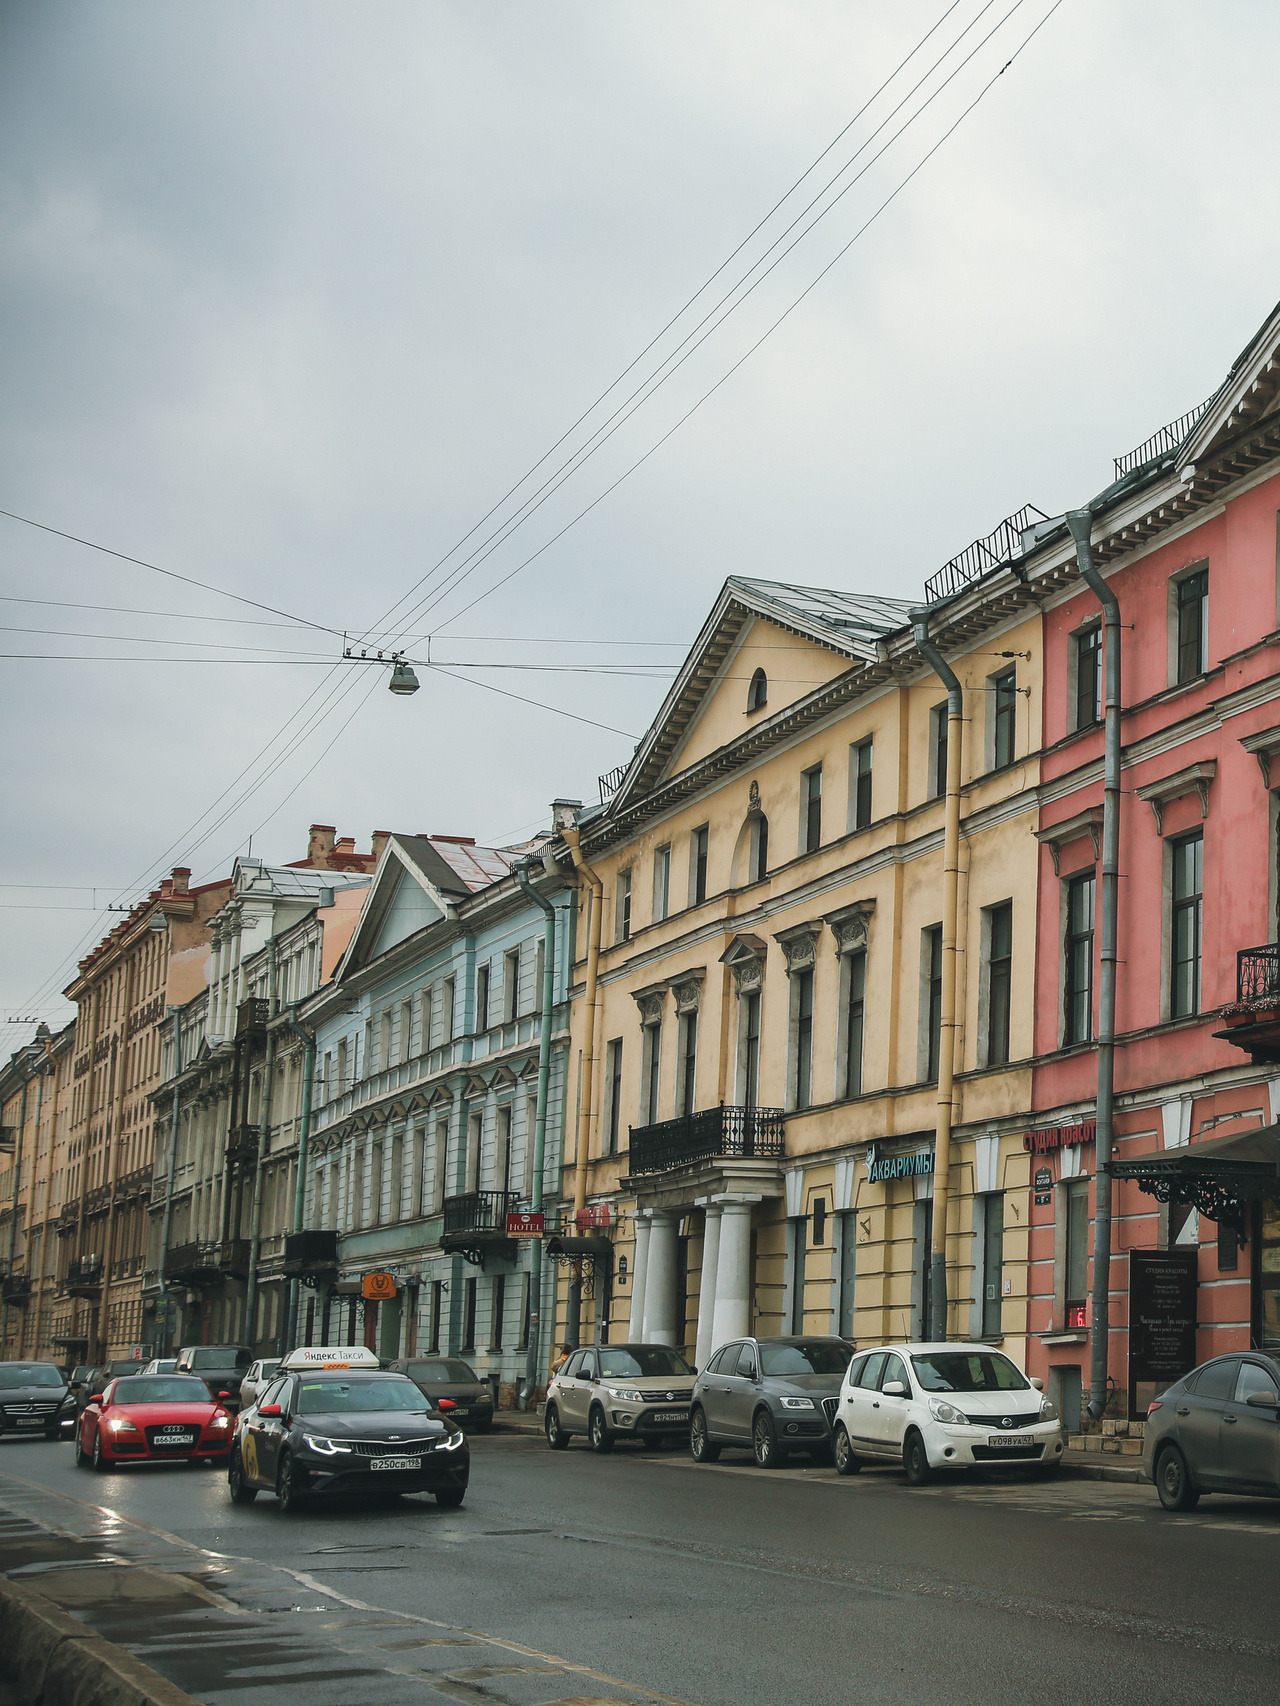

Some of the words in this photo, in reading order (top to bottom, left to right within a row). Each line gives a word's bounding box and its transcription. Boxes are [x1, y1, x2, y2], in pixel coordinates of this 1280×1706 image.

[1022, 1127, 1058, 1154] студия
[1060, 1119, 1097, 1150] красот
[871, 1152, 934, 1181] АКВАРИУМЫ
[304, 1351, 337, 1361] Яндекс
[338, 1351, 364, 1360] Такси
